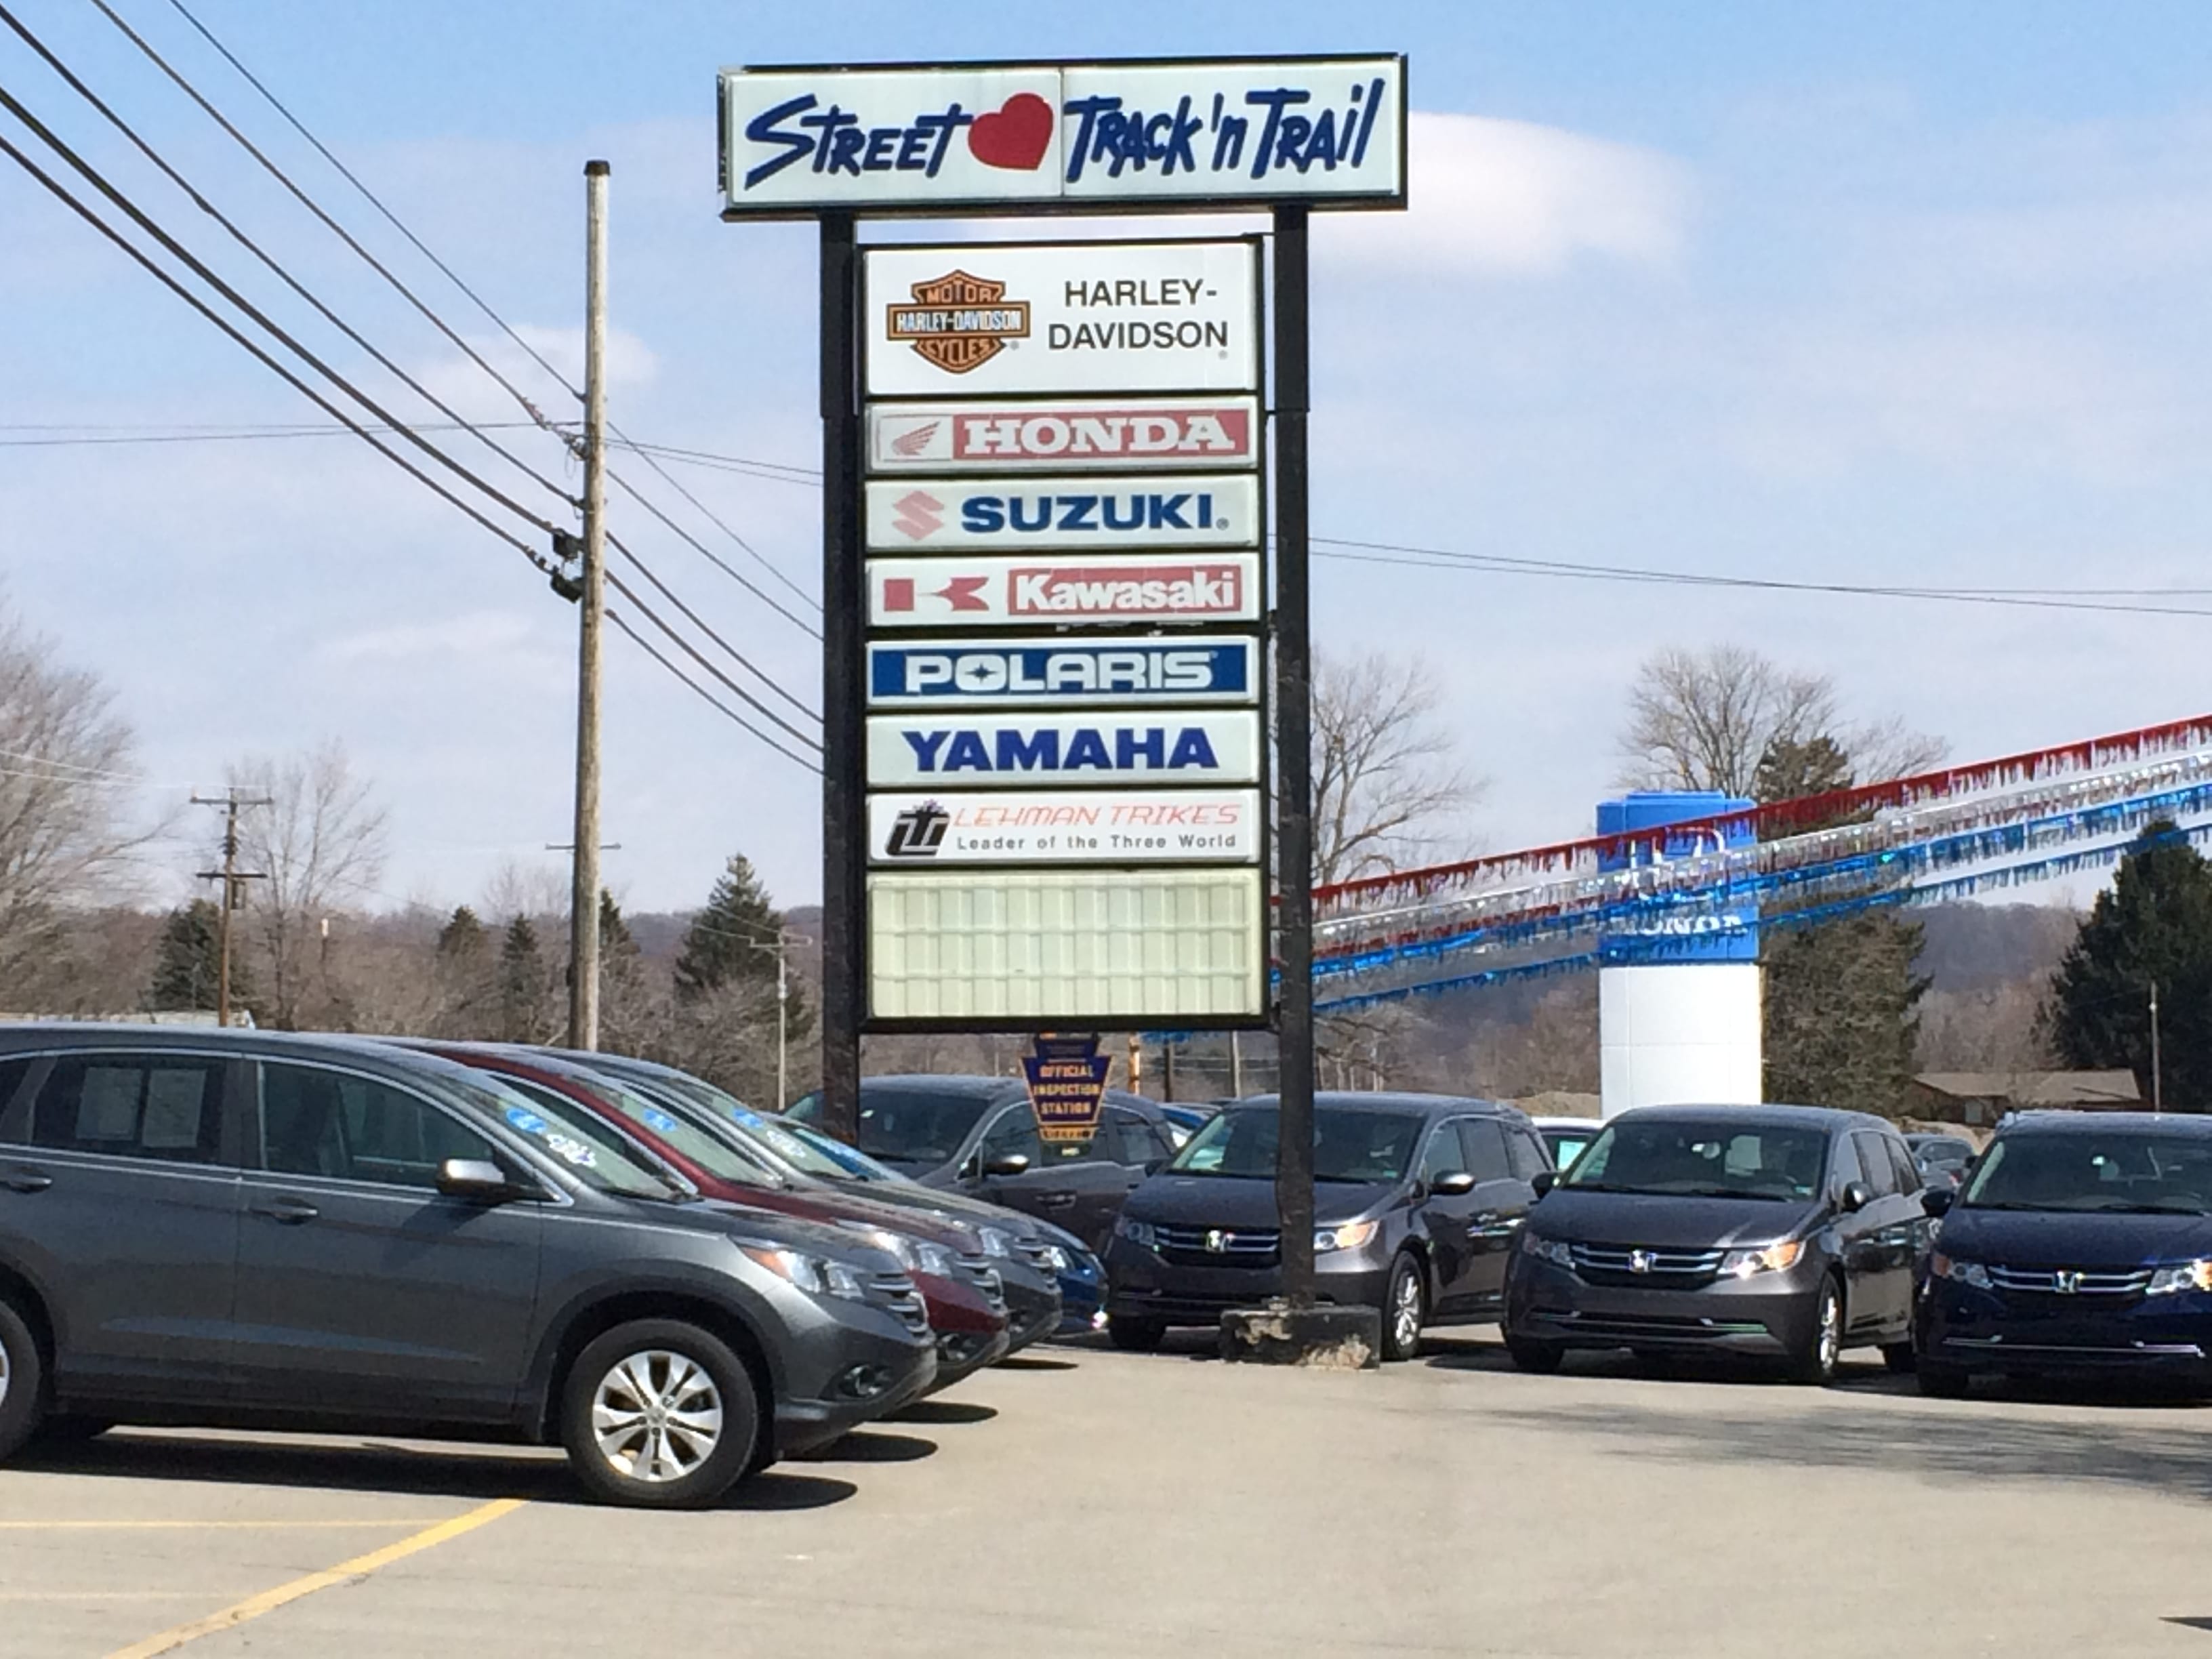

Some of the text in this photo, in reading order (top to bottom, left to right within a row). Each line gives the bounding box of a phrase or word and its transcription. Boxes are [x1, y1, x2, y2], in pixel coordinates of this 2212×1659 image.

[926, 280, 992, 303] MOTOR
[1065, 279, 1217, 306] HARLEY-
[896, 310, 1022, 333] HARLEY-DAVIDSON
[1048, 322, 1228, 350] DAVIDSON
[926, 338, 989, 364] CYCLES
[964, 416, 1235, 454] HONDA
[961, 494, 1212, 533] SUZUKI
[1016, 571, 1235, 610] Kawasaki
[905, 652, 1213, 693] POLARIS
[901, 727, 1220, 772] YAMAHA
[953, 804, 1242, 827] LEHMAN TRIKES
[958, 834, 1236, 850] Leader of the Three World
[1040, 1102, 1091, 1115] STATION
